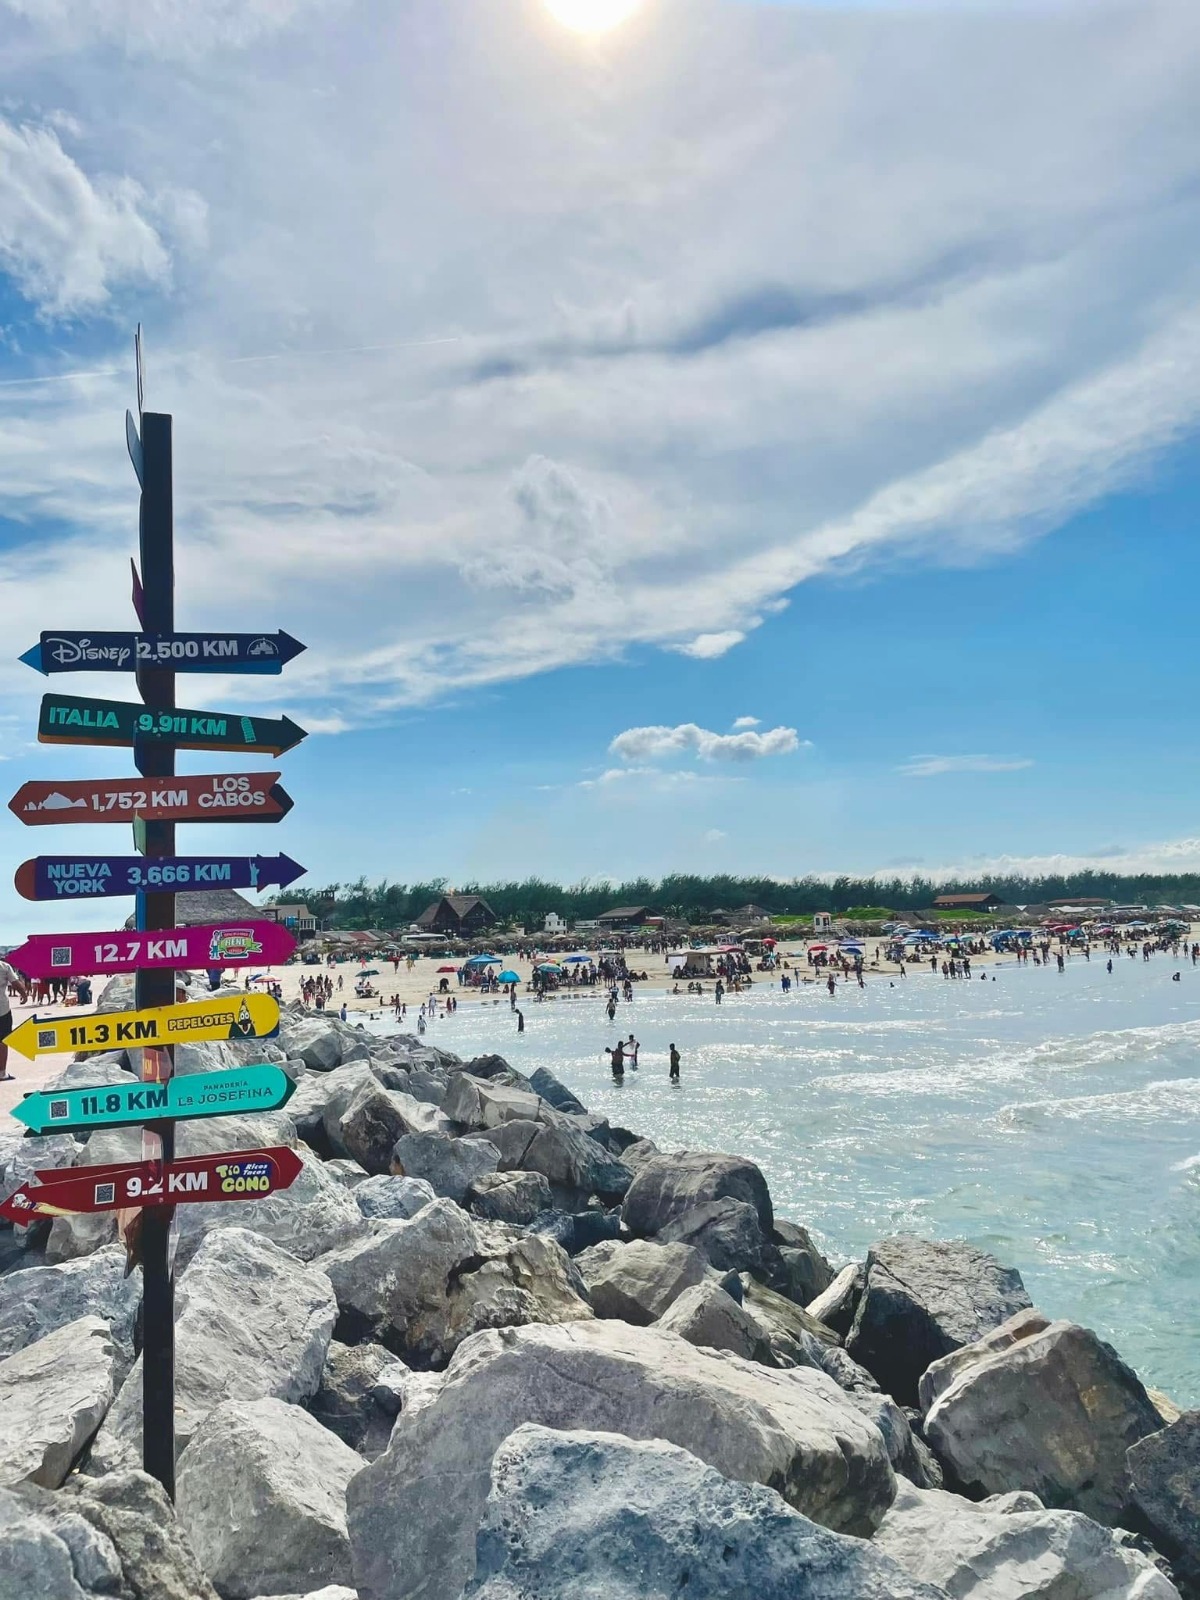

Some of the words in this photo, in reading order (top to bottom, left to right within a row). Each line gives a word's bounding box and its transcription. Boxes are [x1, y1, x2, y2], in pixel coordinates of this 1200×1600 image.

[137, 641, 199, 660] 2,500
[202, 640, 239, 657] KM
[49, 706, 119, 729] ITALIA
[139, 715, 189, 734] 9,911
[191, 717, 227, 736] KM
[213, 777, 249, 792] LOS
[91, 791, 147, 813] 1,752
[151, 789, 188, 807] KM
[198, 791, 265, 808] CABOS
[47, 863, 112, 879] NUEVA
[127, 865, 190, 886] 3,666
[194, 863, 231, 881] KM
[54, 879, 105, 894] YORK
[95, 942, 141, 963] 12.7
[147, 939, 188, 959] KM
[168, 1013, 235, 1031] PEPELOTES
[70, 1025, 109, 1046] 11.3
[116, 1020, 157, 1041] KM
[81, 1094, 121, 1116] 11.8
[127, 1089, 168, 1111] KM
[198, 1087, 273, 1104] JOSEFINA
[126, 1176, 163, 1197] 9.2
[168, 1171, 208, 1193] KM
